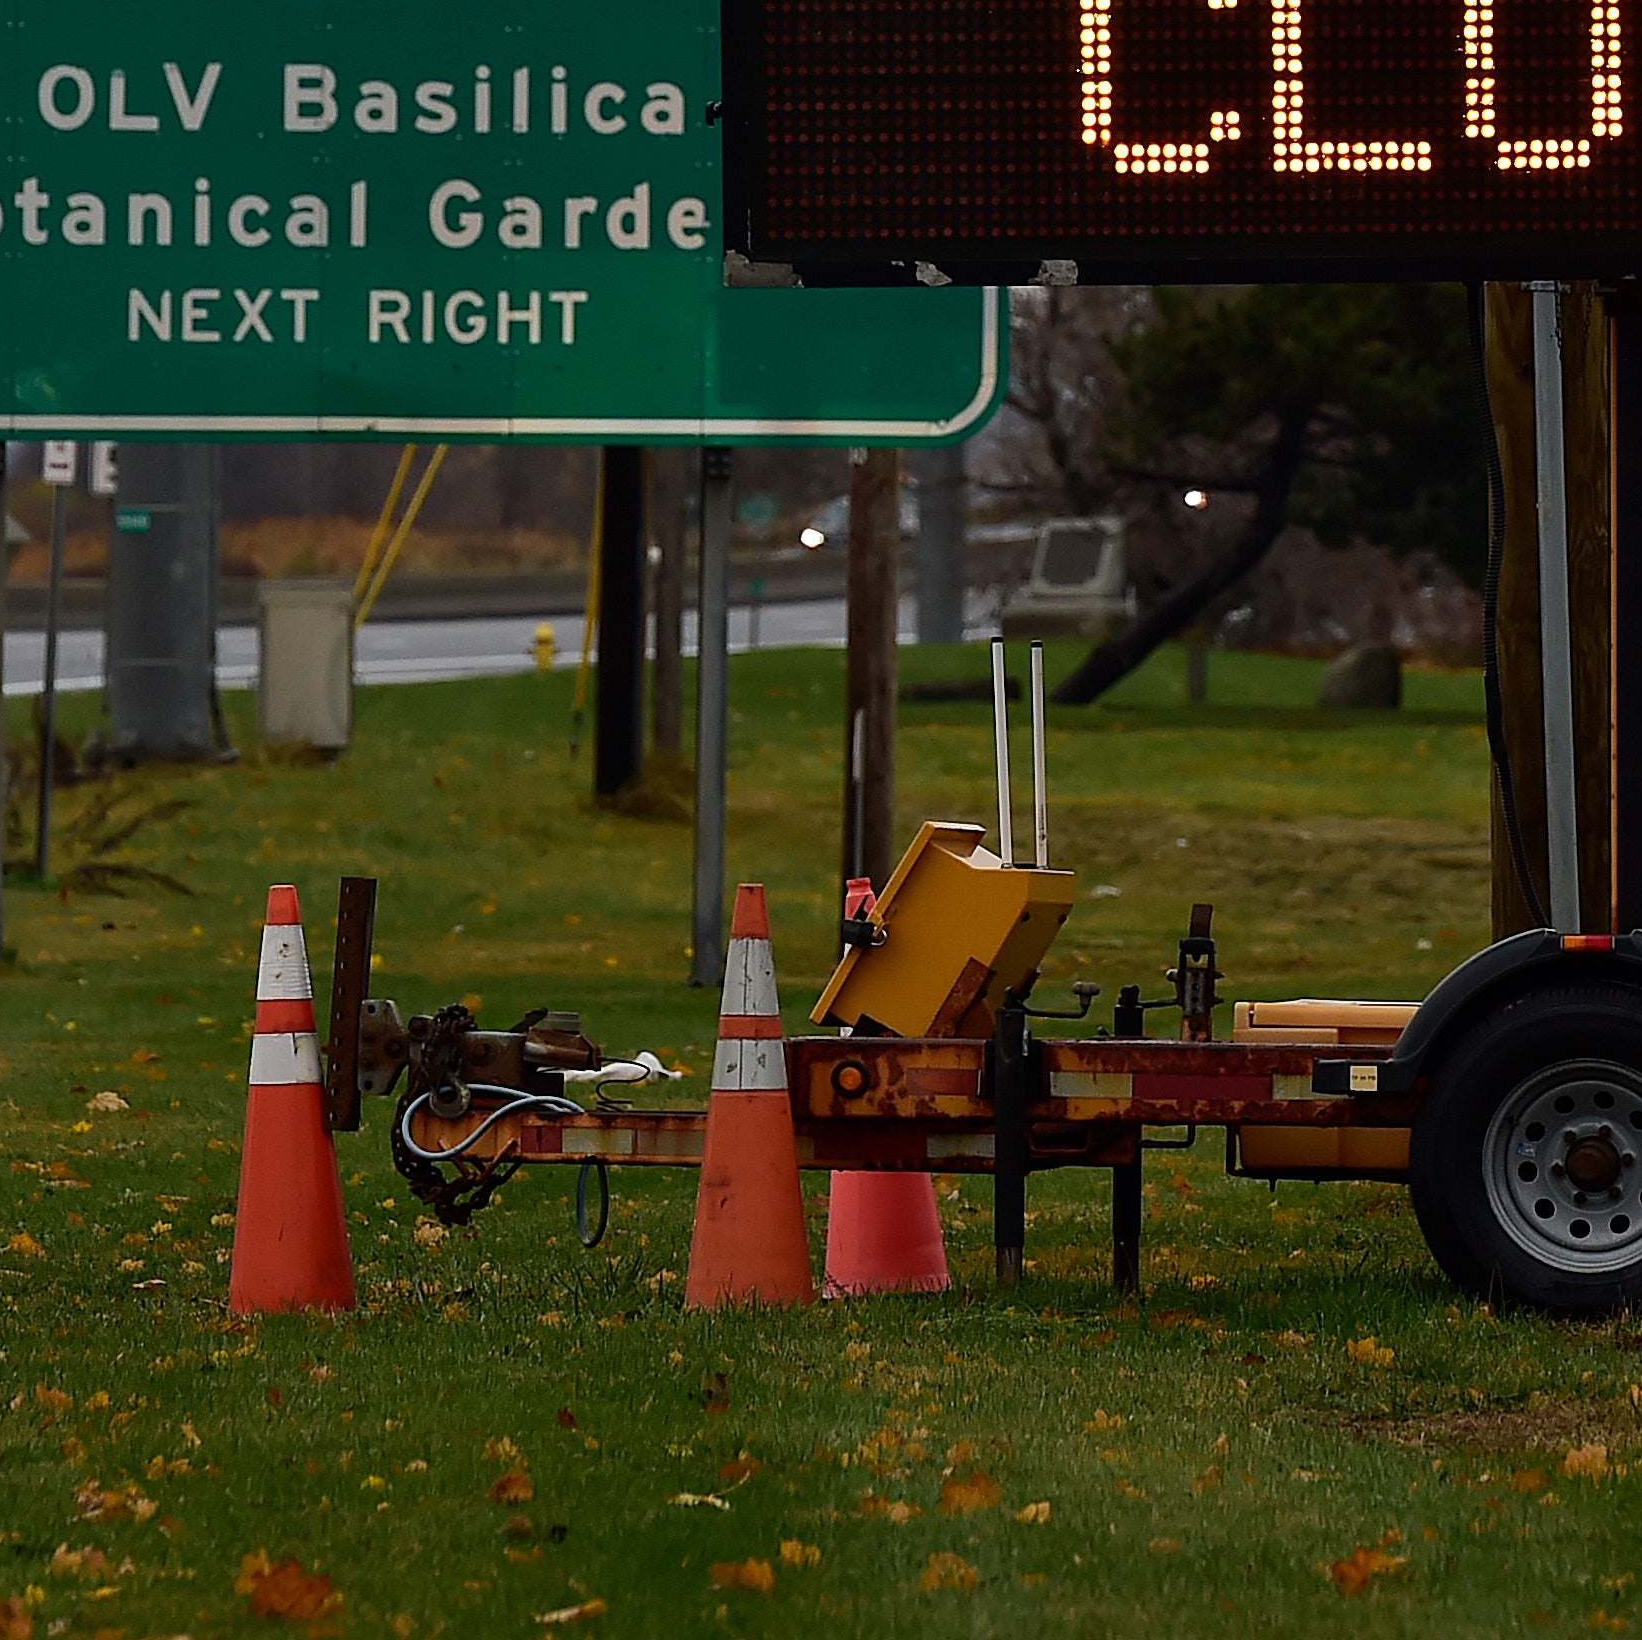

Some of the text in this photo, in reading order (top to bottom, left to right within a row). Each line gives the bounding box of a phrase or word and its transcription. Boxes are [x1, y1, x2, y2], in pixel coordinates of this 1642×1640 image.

[39, 62, 685, 136] OLV Basilica
[428, 179, 711, 250] Garde
[127, 287, 589, 346] NEXT RIGHT
